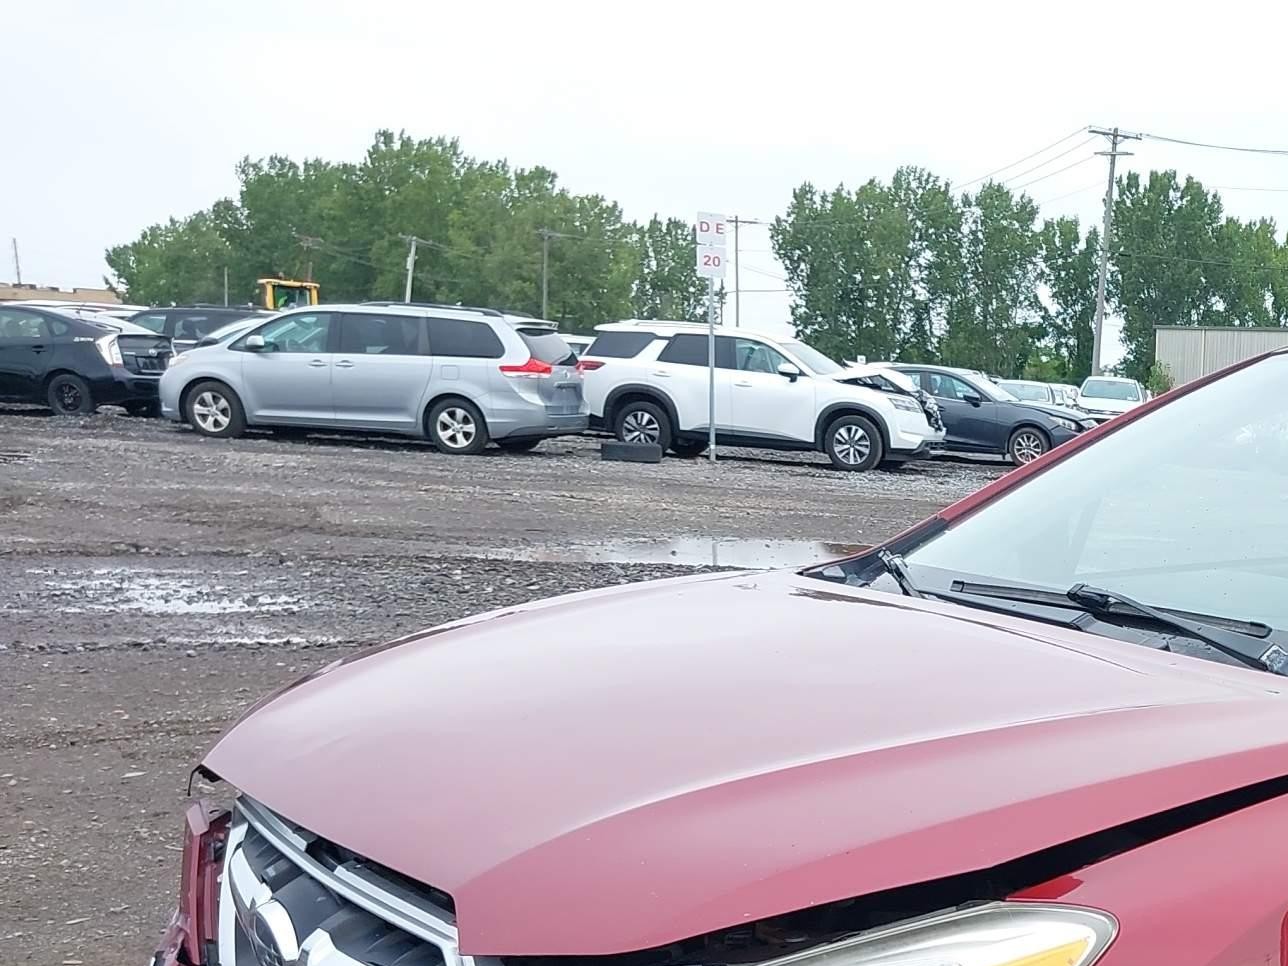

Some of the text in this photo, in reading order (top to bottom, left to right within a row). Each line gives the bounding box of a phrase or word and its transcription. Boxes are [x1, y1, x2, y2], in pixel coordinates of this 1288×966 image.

[700, 221, 725, 235] D E
[703, 254, 721, 267] 20
